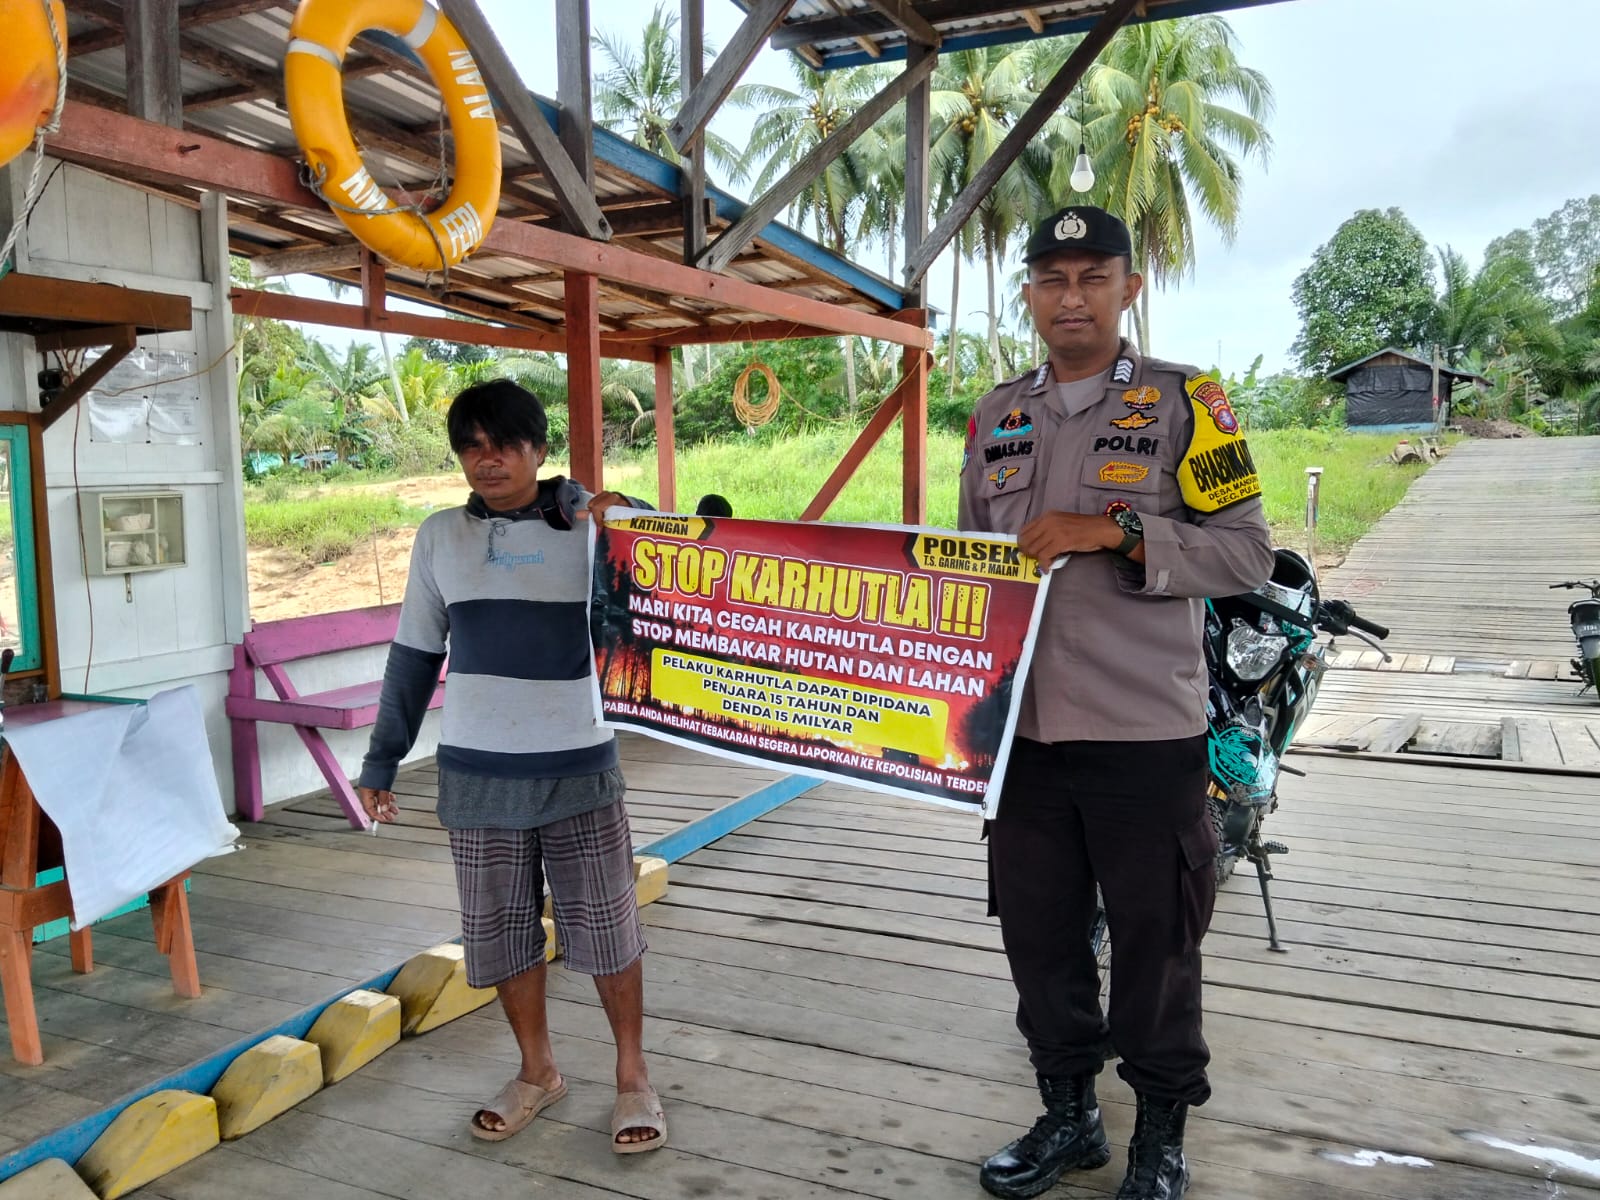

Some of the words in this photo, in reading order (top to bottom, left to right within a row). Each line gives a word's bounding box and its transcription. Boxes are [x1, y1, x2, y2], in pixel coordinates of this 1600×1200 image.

[440, 201, 483, 259] FERI
[1094, 435, 1160, 456] POLRI
[1208, 486, 1233, 501] DESA
[629, 517, 689, 536] KATINGAN
[923, 537, 1020, 565] POLSEK
[923, 555, 937, 566] T.S.
[938, 557, 970, 572] GARING
[972, 563, 978, 573] &
[980, 561, 987, 574] P.
[988, 564, 1019, 578] MALAN
[633, 540, 726, 598] STOP
[729, 554, 931, 630] KARHUTLA
[939, 581, 987, 637] !!!
[629, 594, 670, 618] MARI
[673, 602, 713, 626] KITA
[717, 610, 782, 637] CEGAH
[786, 620, 895, 656] KARHUTLA
[898, 639, 993, 671] DENGAN
[632, 618, 672, 642] STOP
[675, 629, 781, 663] MEMBAKAR
[785, 647, 854, 675] HUTAN
[858, 660, 904, 685] DAN
[908, 668, 985, 698] LAHAN
[662, 655, 714, 675] PELAKU
[716, 666, 793, 692] KARHUTLA
[797, 681, 849, 701] DAPAT
[852, 691, 931, 717] DIPIDANA
[703, 679, 766, 701] PENJARA
[770, 693, 783, 705] 15
[787, 695, 842, 714] TAHUN
[846, 705, 880, 722] DAN
[722, 699, 772, 719] DENDA
[775, 710, 788, 723] 15
[792, 714, 853, 734] MILYAR
[603, 701, 638, 715] PABILA
[639, 706, 663, 723] ANDA
[664, 713, 700, 732] MELIHAT
[701, 721, 757, 747] KEBAKARAN
[759, 735, 798, 755] SEGERA
[800, 743, 859, 767] LAPORKAN
[860, 757, 874, 771] KE
[875, 760, 942, 785] KEPOLISIAN
